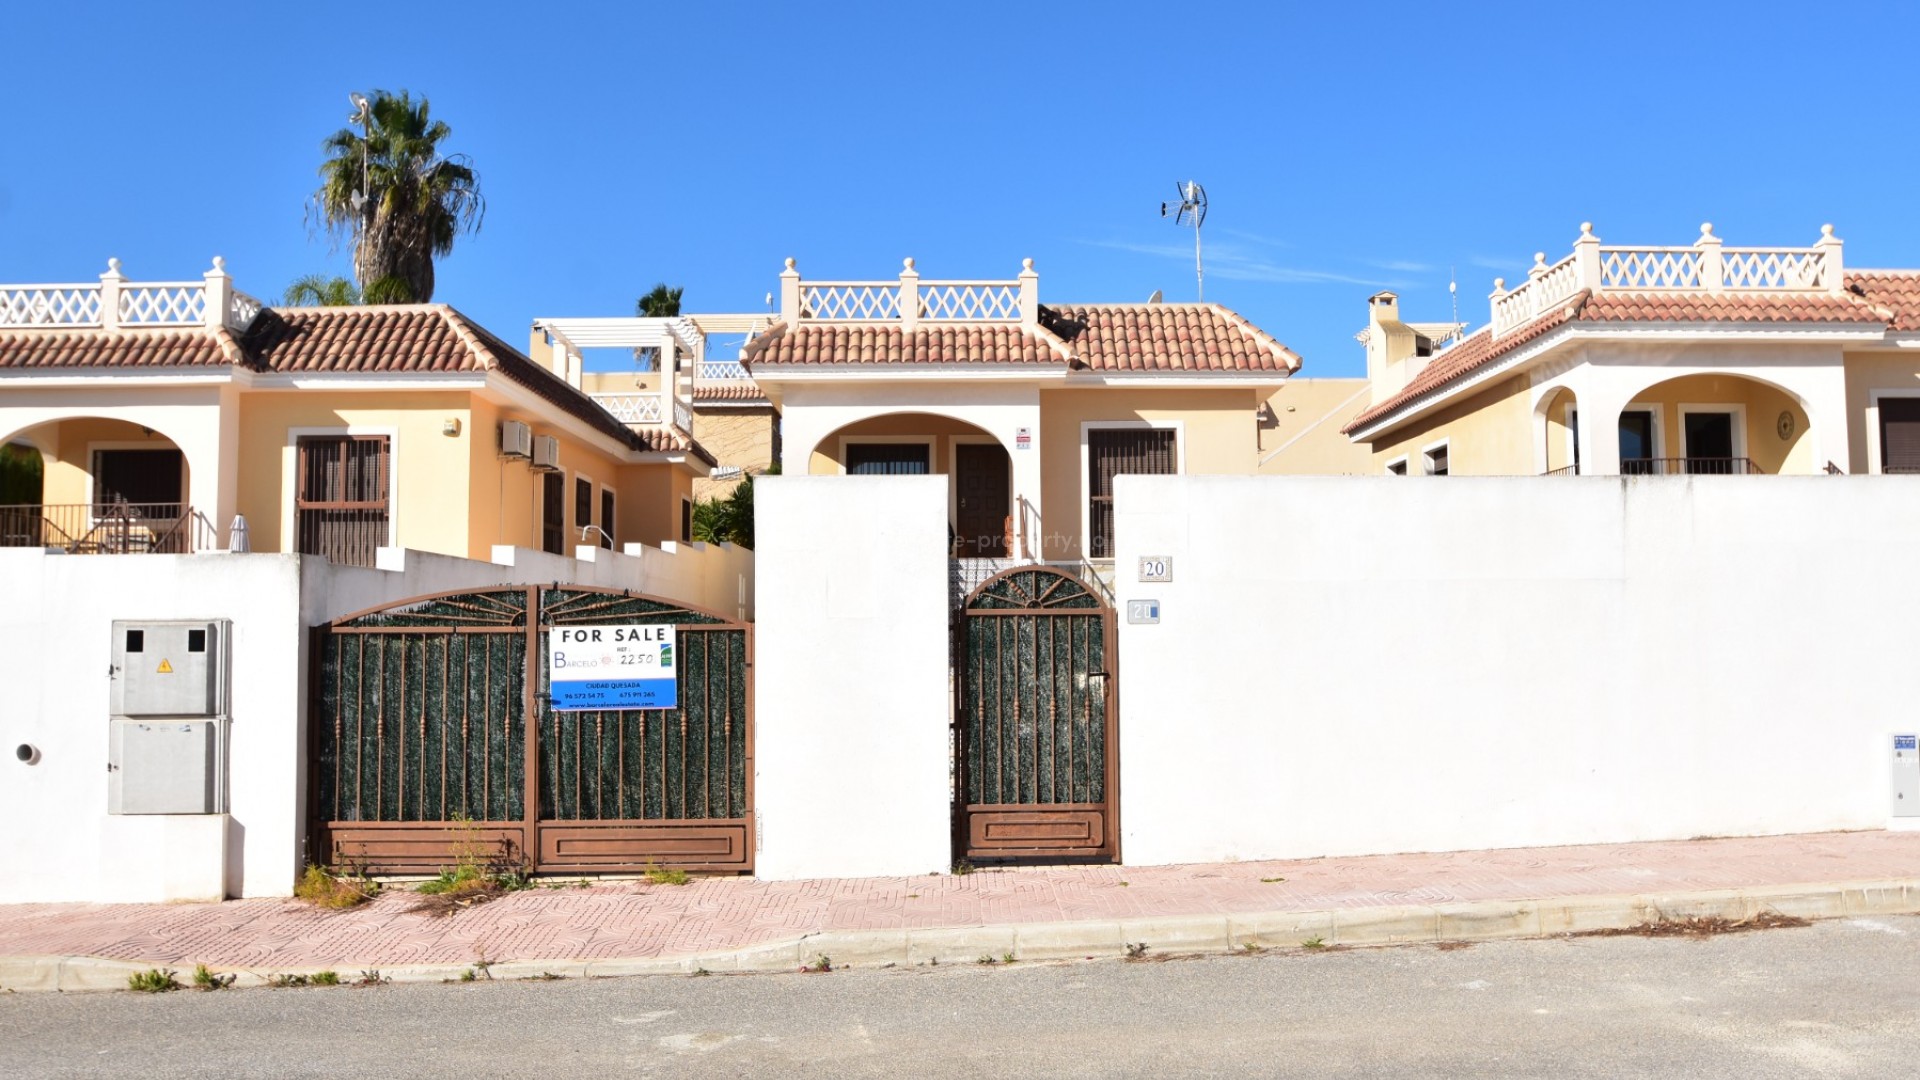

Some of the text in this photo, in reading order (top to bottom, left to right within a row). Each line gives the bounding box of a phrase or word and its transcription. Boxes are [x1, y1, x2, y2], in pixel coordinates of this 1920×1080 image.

[1146, 561, 1164, 576] 20
[562, 628, 665, 643] FOR SALE
[620, 654, 654, 665] 2250
